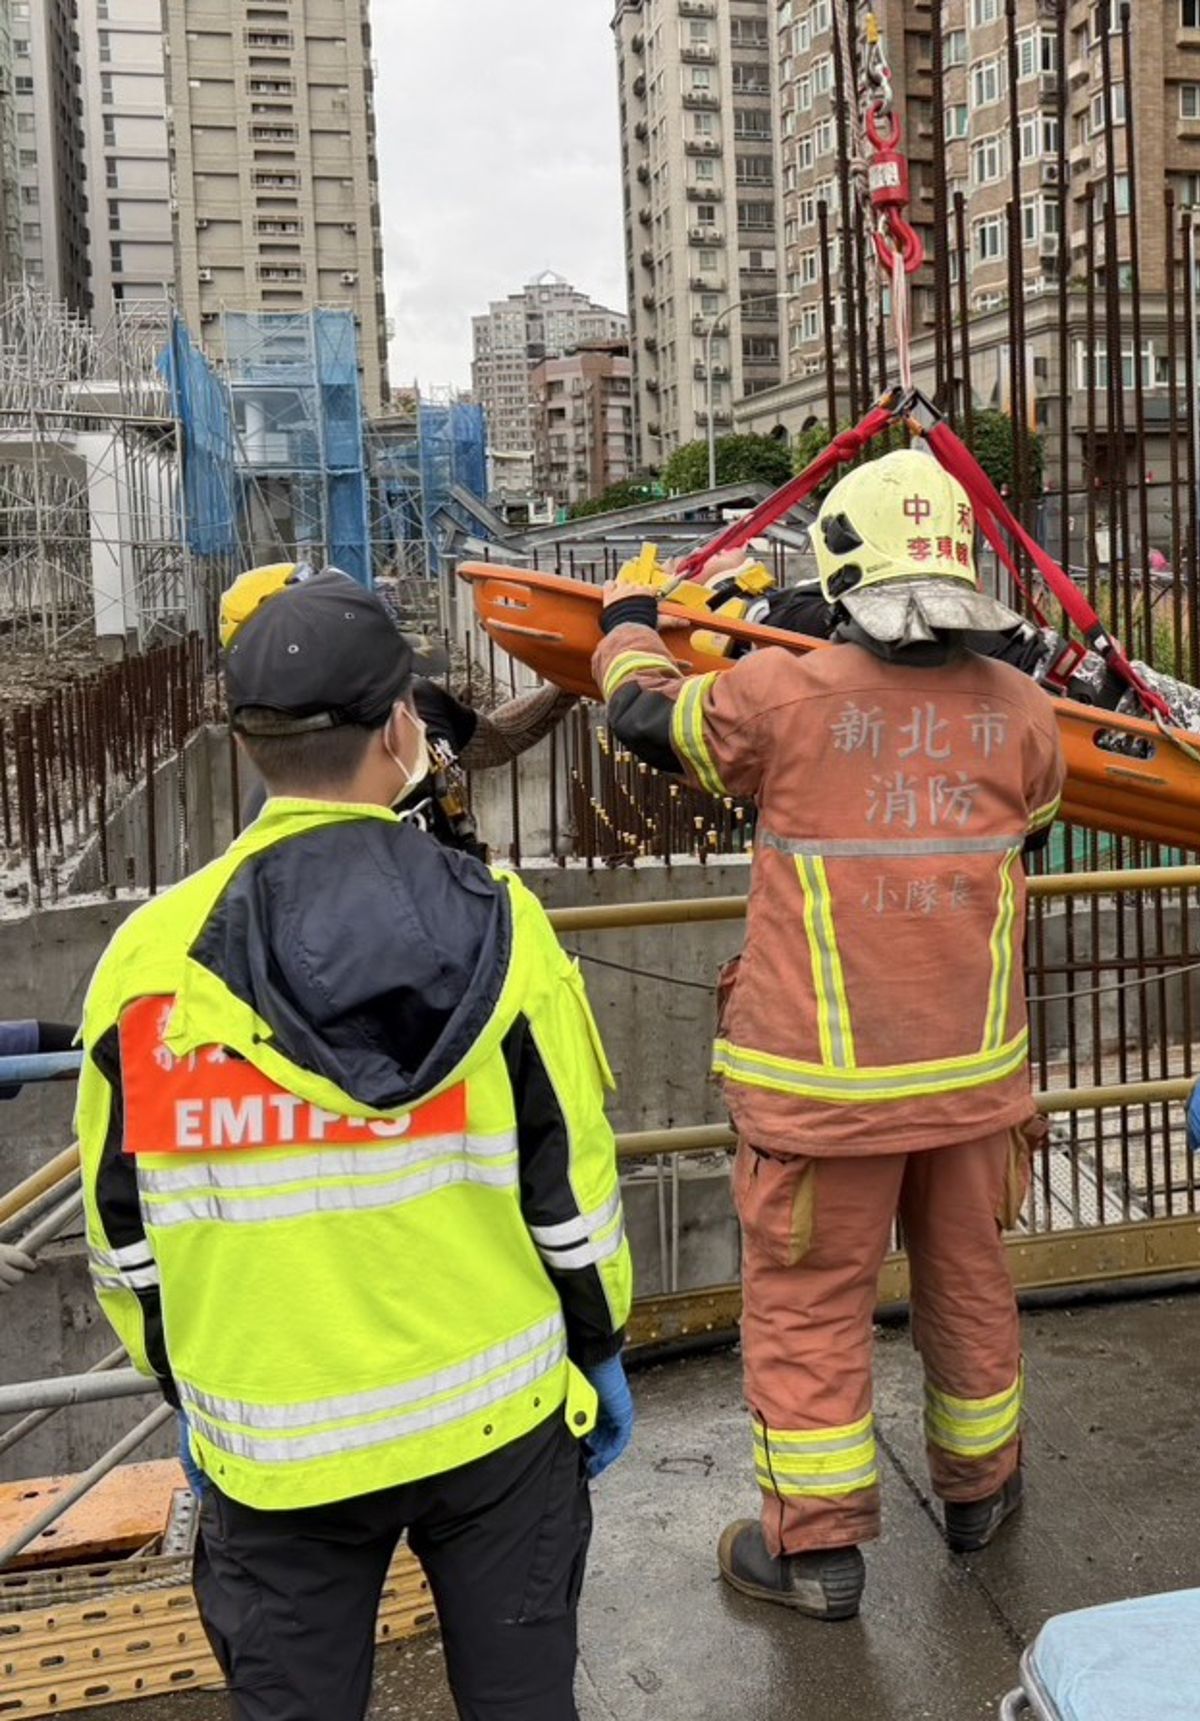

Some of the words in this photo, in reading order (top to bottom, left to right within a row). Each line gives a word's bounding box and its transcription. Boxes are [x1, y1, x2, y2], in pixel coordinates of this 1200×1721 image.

[830, 701, 1008, 759] 新北市
[865, 771, 979, 831] 消防
[861, 874, 973, 915] 小隊長
